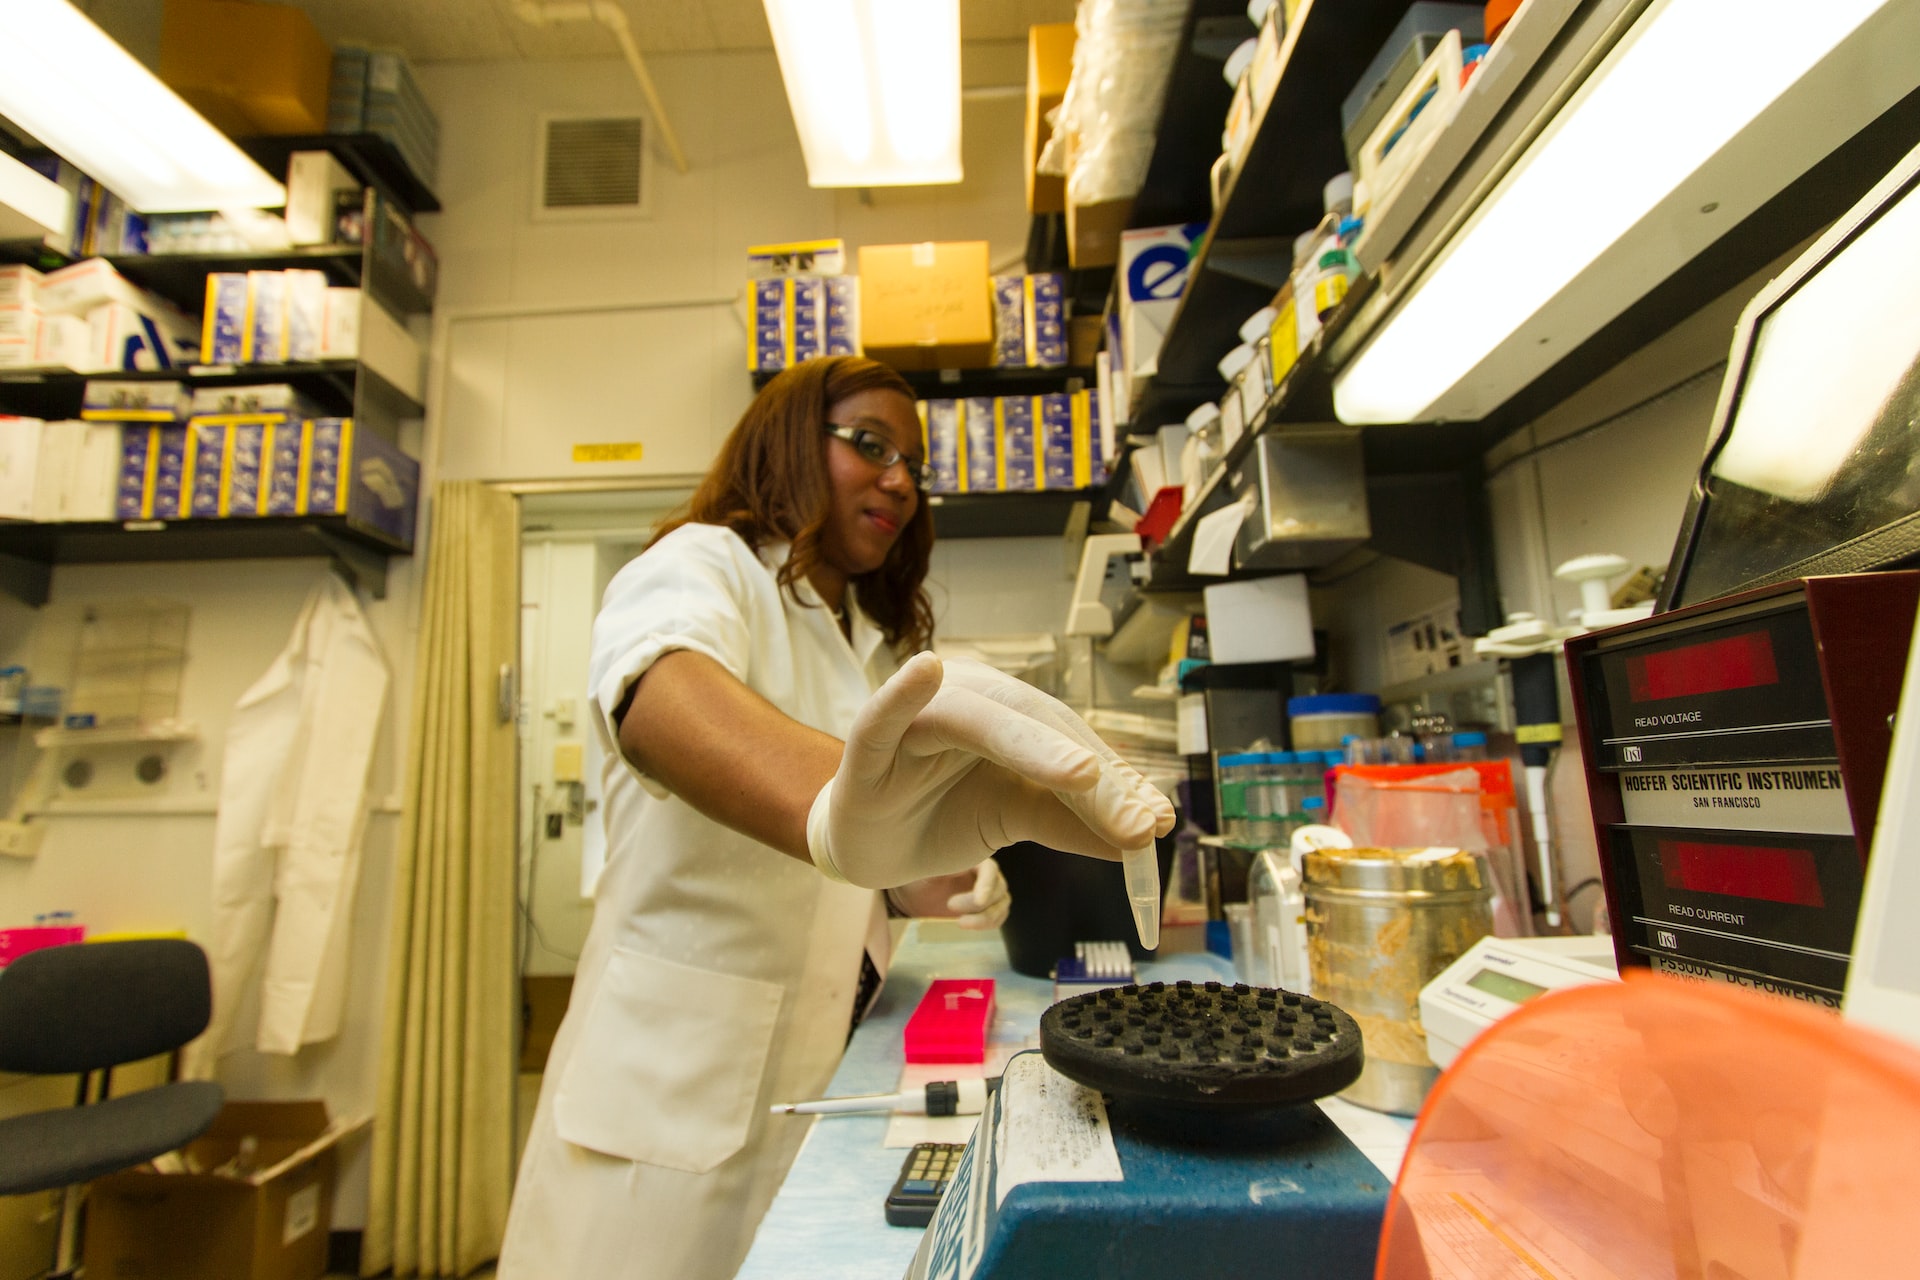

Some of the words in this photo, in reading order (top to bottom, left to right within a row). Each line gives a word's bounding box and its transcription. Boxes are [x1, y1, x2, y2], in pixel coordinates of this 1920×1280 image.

[1635, 716, 1659, 728] READ
[1660, 711, 1702, 725] VOLTAGE
[1625, 775, 1667, 791] HOEFER
[1672, 772, 1743, 791] SCIENTIFIC
[1693, 797, 1709, 808] SAN
[1712, 797, 1761, 808] FRANCISCO
[1668, 904, 1695, 917] READ
[1696, 908, 1745, 926] CURRENT
